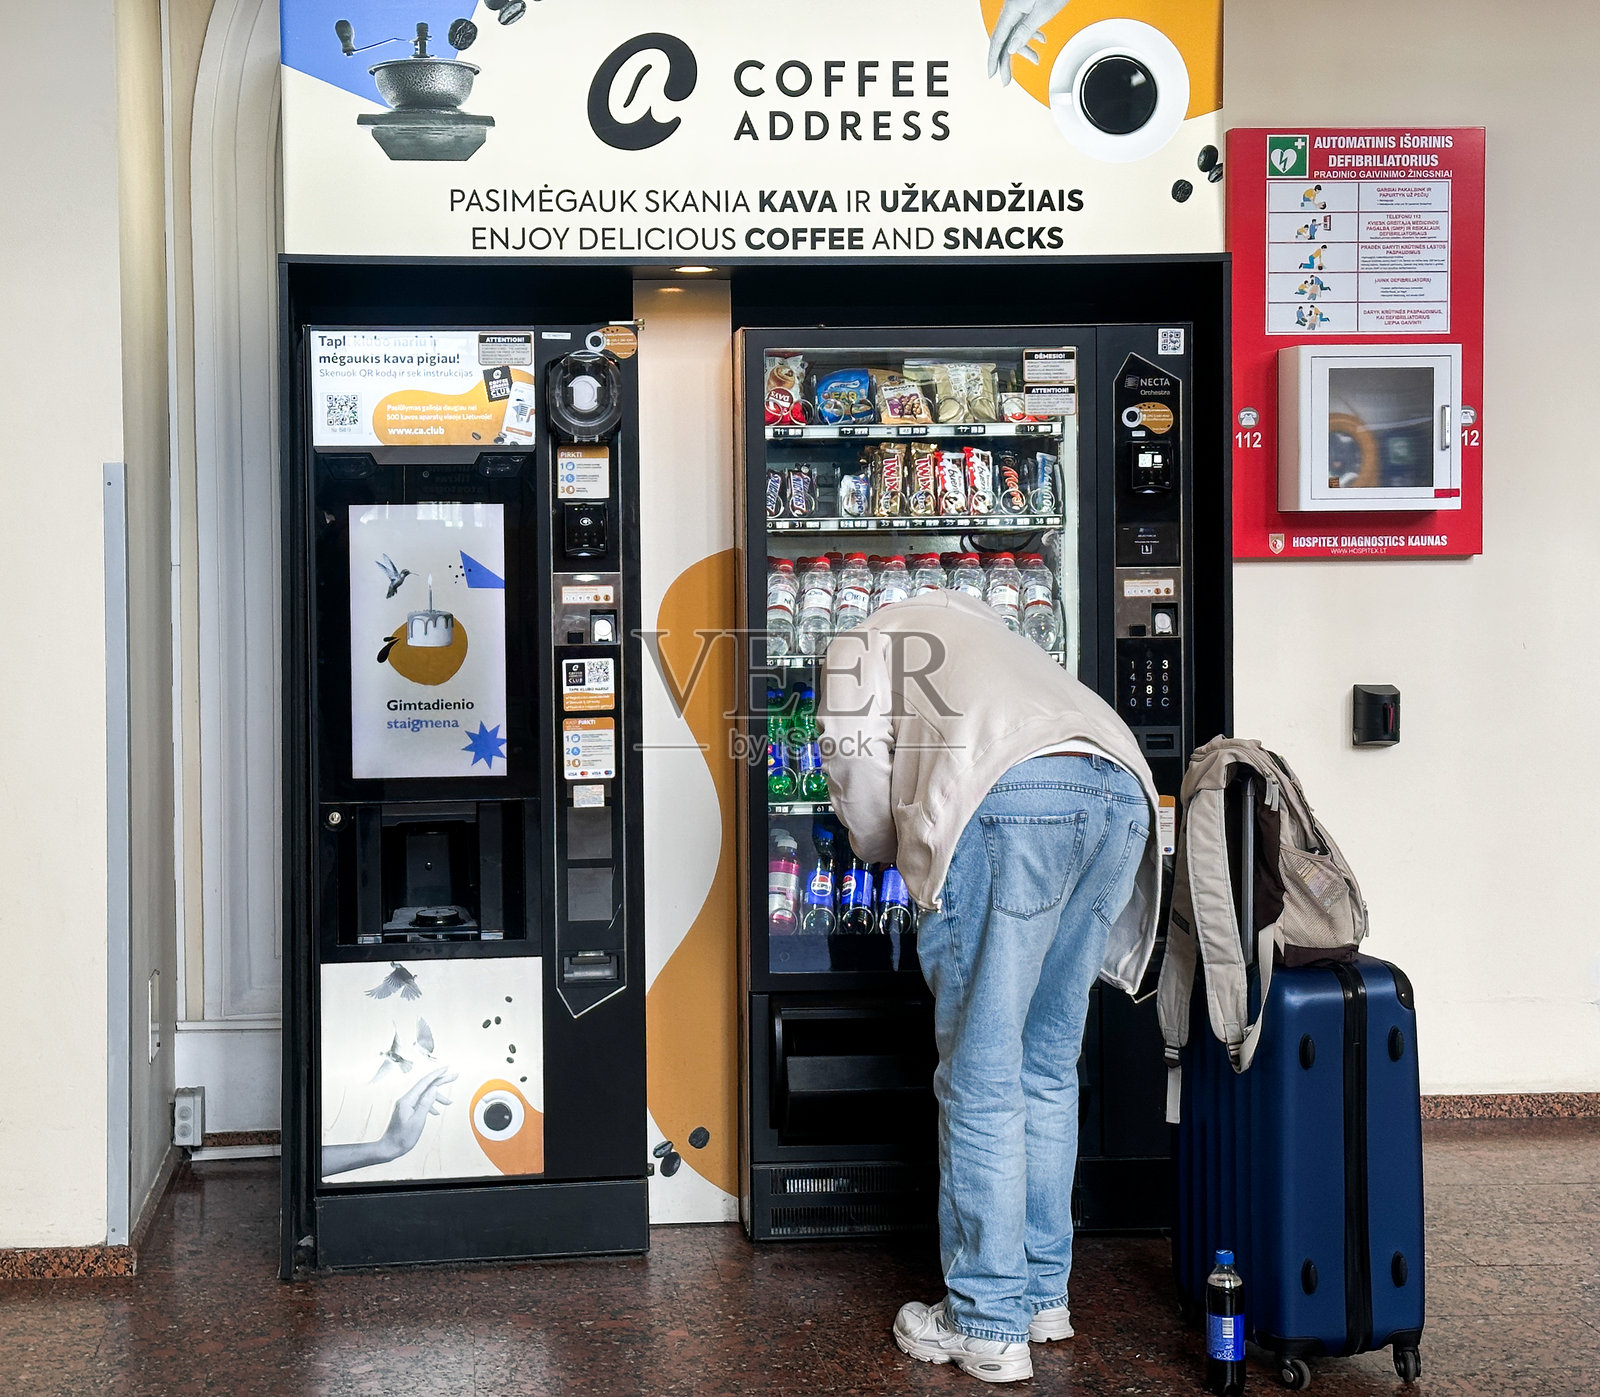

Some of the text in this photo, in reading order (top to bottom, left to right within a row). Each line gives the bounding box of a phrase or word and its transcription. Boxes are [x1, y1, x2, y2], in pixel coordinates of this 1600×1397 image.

[734, 60, 949, 97] COFFEE
[734, 110, 950, 141] ADDRESS
[1314, 133, 1453, 149] AUTOMATINIS IŠORINIS
[1329, 154, 1439, 167] DEFIBRILIATORIUS
[1313, 167, 1453, 179] PRADINIO GAIVINIMO ŽINGSNIAI
[450, 182, 1084, 213] PASIMĖGAUK SKANIA KAVA IR UŽKANDŽIAIS
[472, 227, 1064, 251] ENJOY DELICIOUS COFFEE AND SNACKS
[319, 353, 460, 366] mėgaukis kava pigiau!
[319, 368, 473, 379] Skenuok QR kodą ir sek instrukcijas
[1140, 377, 1171, 387] NECTA
[386, 413, 400, 421] 500
[388, 426, 445, 435] www.ca.club
[1235, 432, 1262, 448] 112
[1461, 429, 1480, 447] 12
[1292, 535, 1448, 548] HOSPITEX DIAGNOSTICS KAUNAS
[1130, 660, 1169, 669] 1 2 3
[1129, 673, 1168, 682] 4 5 6
[1130, 685, 1169, 694] 7 8 9
[387, 699, 475, 711] Gimtadienio
[1130, 698, 1170, 707] 0 E C
[387, 717, 460, 732] staigmena
